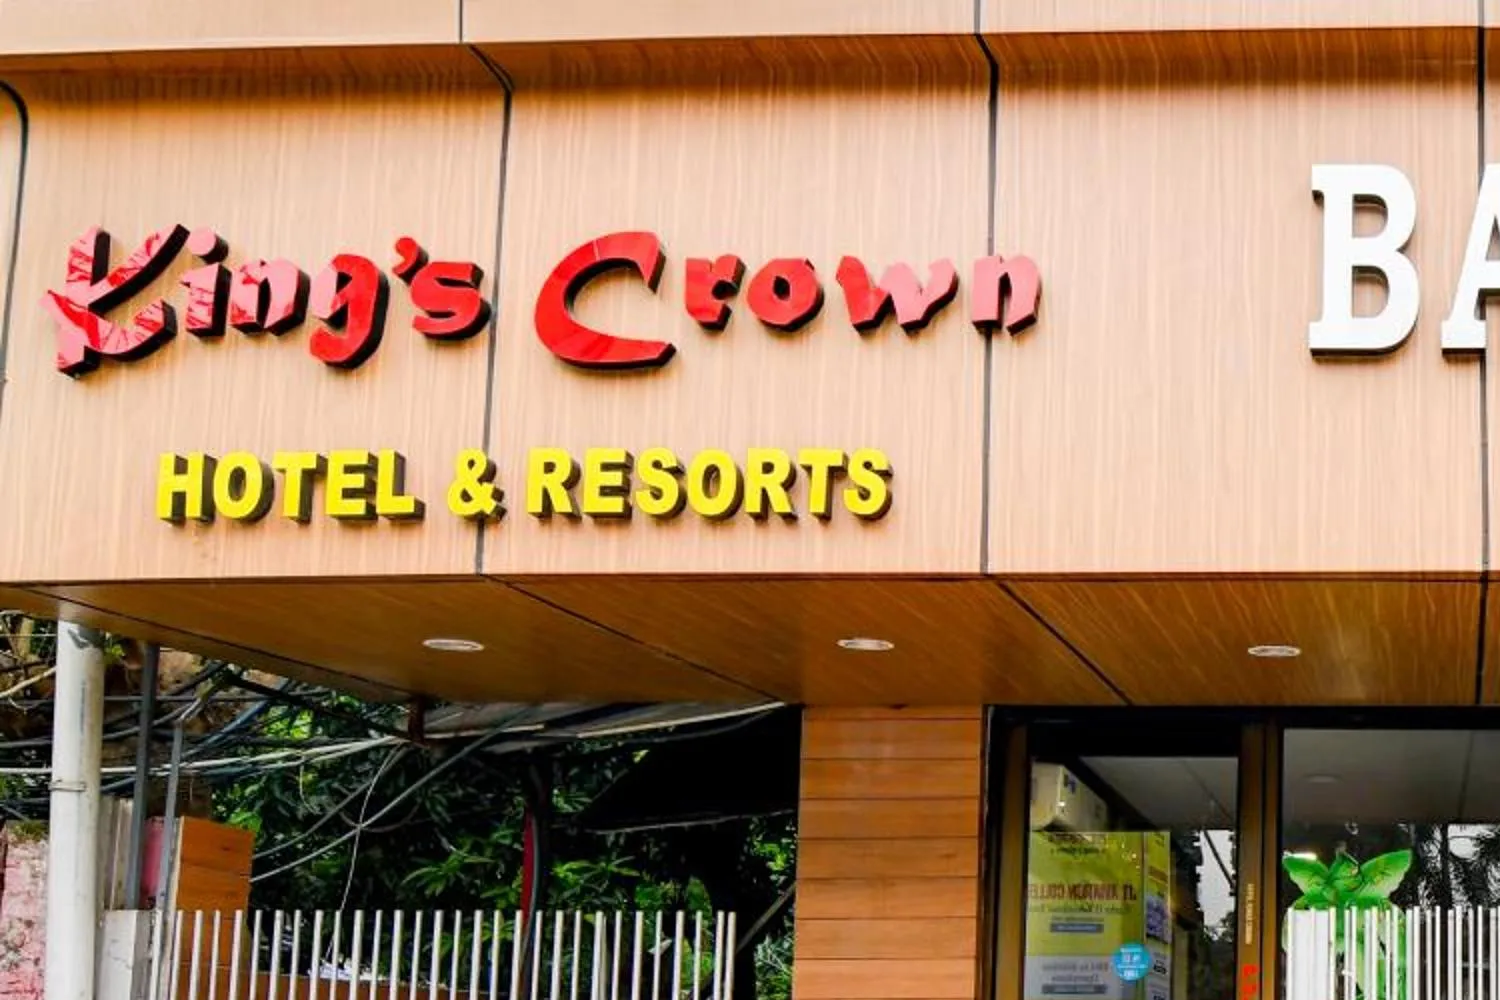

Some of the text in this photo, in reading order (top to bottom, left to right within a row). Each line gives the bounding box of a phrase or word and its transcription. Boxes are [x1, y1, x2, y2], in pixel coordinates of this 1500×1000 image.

[40, 224, 1042, 378] King's Crown
[156, 447, 893, 525] HOTEL & RESORTS
